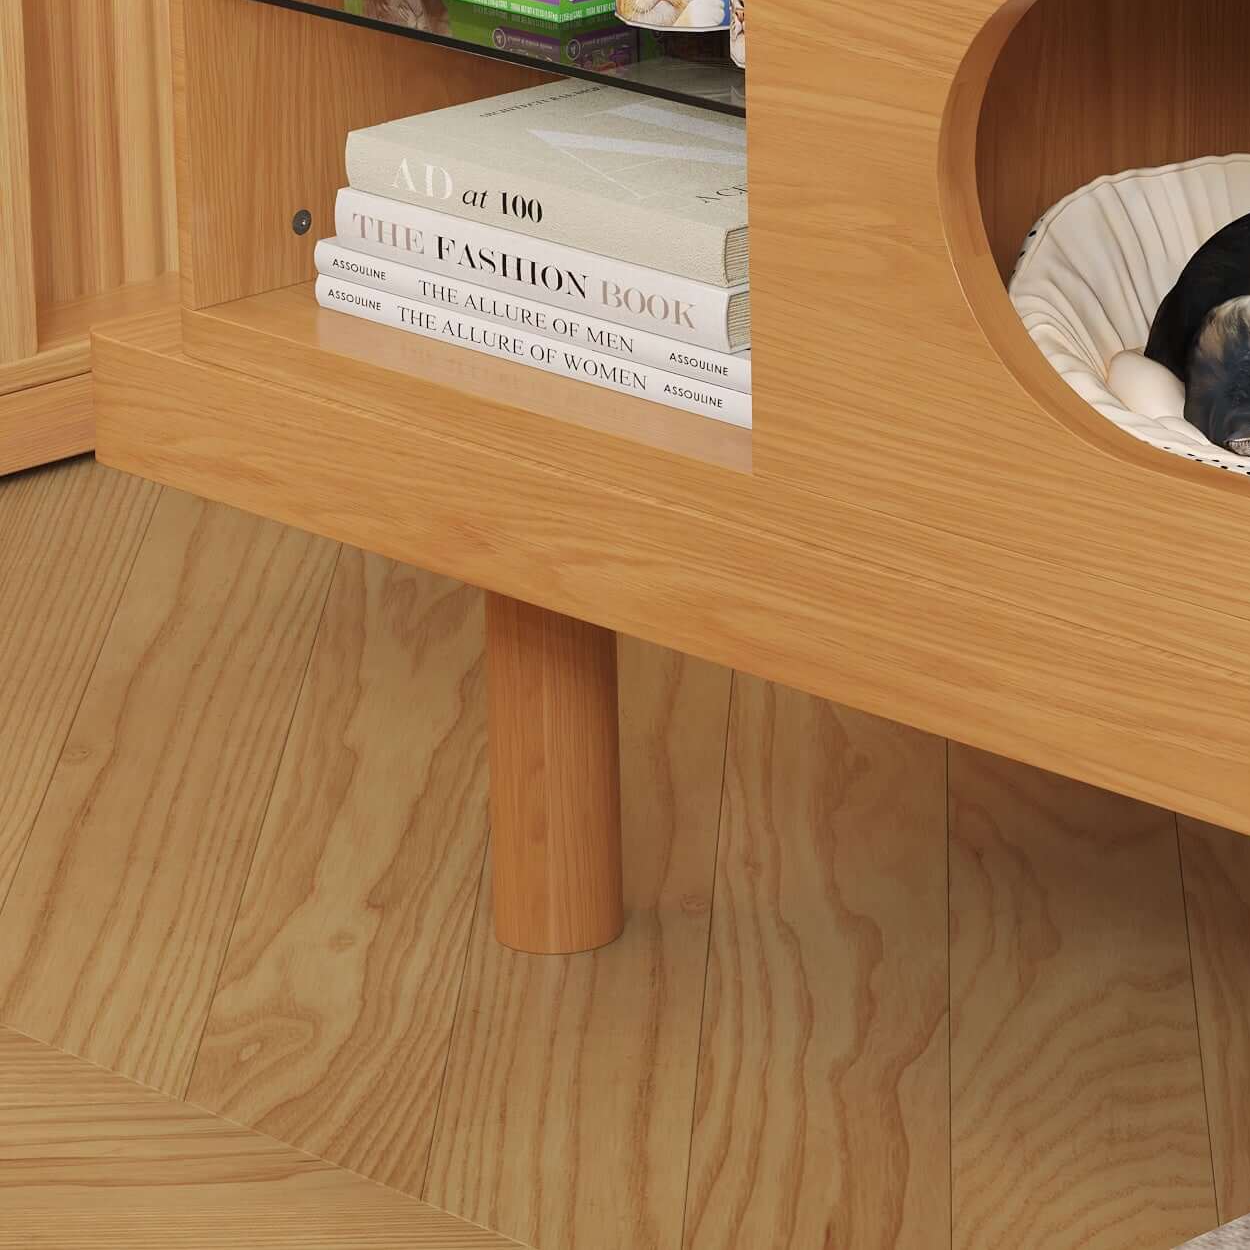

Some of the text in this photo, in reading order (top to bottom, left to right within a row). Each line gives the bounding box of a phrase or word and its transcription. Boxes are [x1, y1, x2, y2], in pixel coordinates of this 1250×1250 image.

[391, 157, 543, 223] AD at 100
[332, 258, 729, 376] ASSOULINE THE ALLURE OF MEN ASSOULINE
[352, 213, 697, 330] THE FASHION BOOK
[328, 288, 723, 409] ASSOULINE THE ALLURE OF WOMEN ASSOULINE
